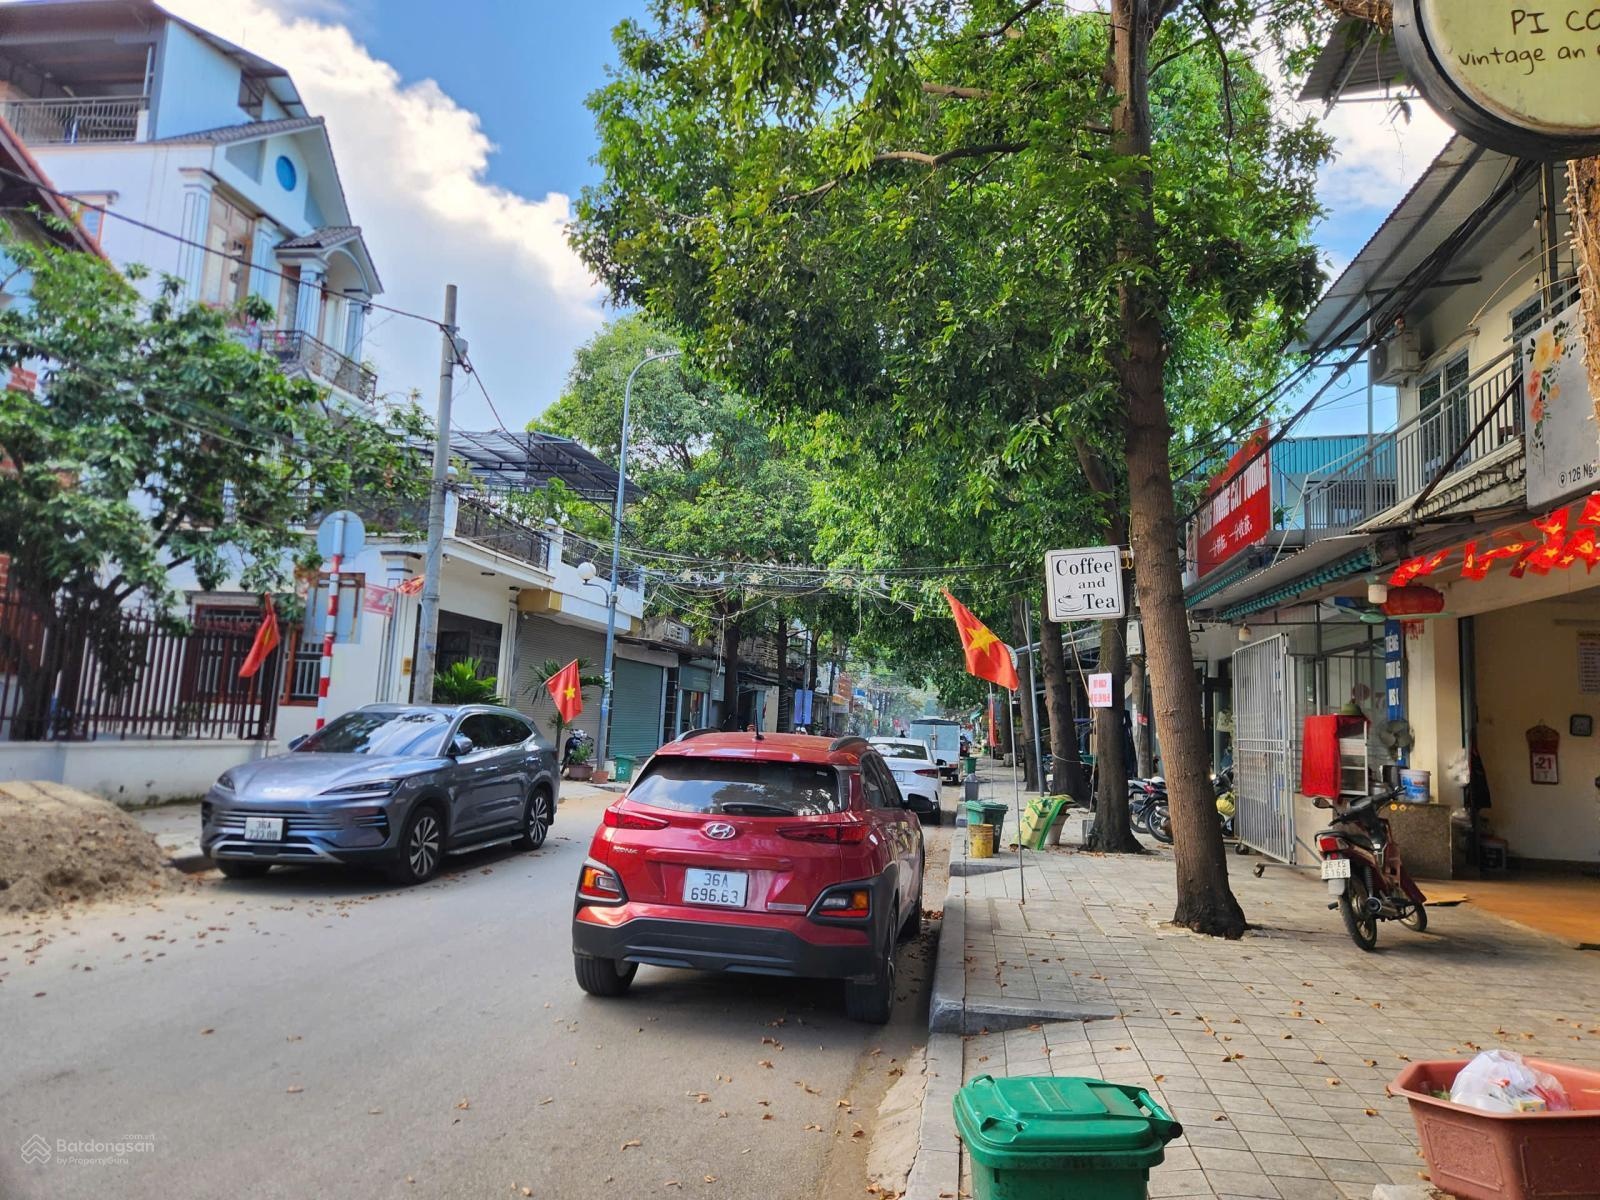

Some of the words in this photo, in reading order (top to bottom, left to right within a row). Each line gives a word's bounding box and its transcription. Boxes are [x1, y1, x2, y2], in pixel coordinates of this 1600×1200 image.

[1511, 9, 1550, 35] PI
[1458, 46, 1546, 75] vintage
[1558, 46, 1585, 59] an
[1568, 466, 1581, 483] 126
[1056, 557, 1113, 577] Coffee
[1078, 577, 1106, 590] and
[1083, 593, 1116, 610] Tea
[1535, 757, 1552, 769] 21
[703, 873, 729, 888] 36A
[690, 888, 739, 904] 696.63
